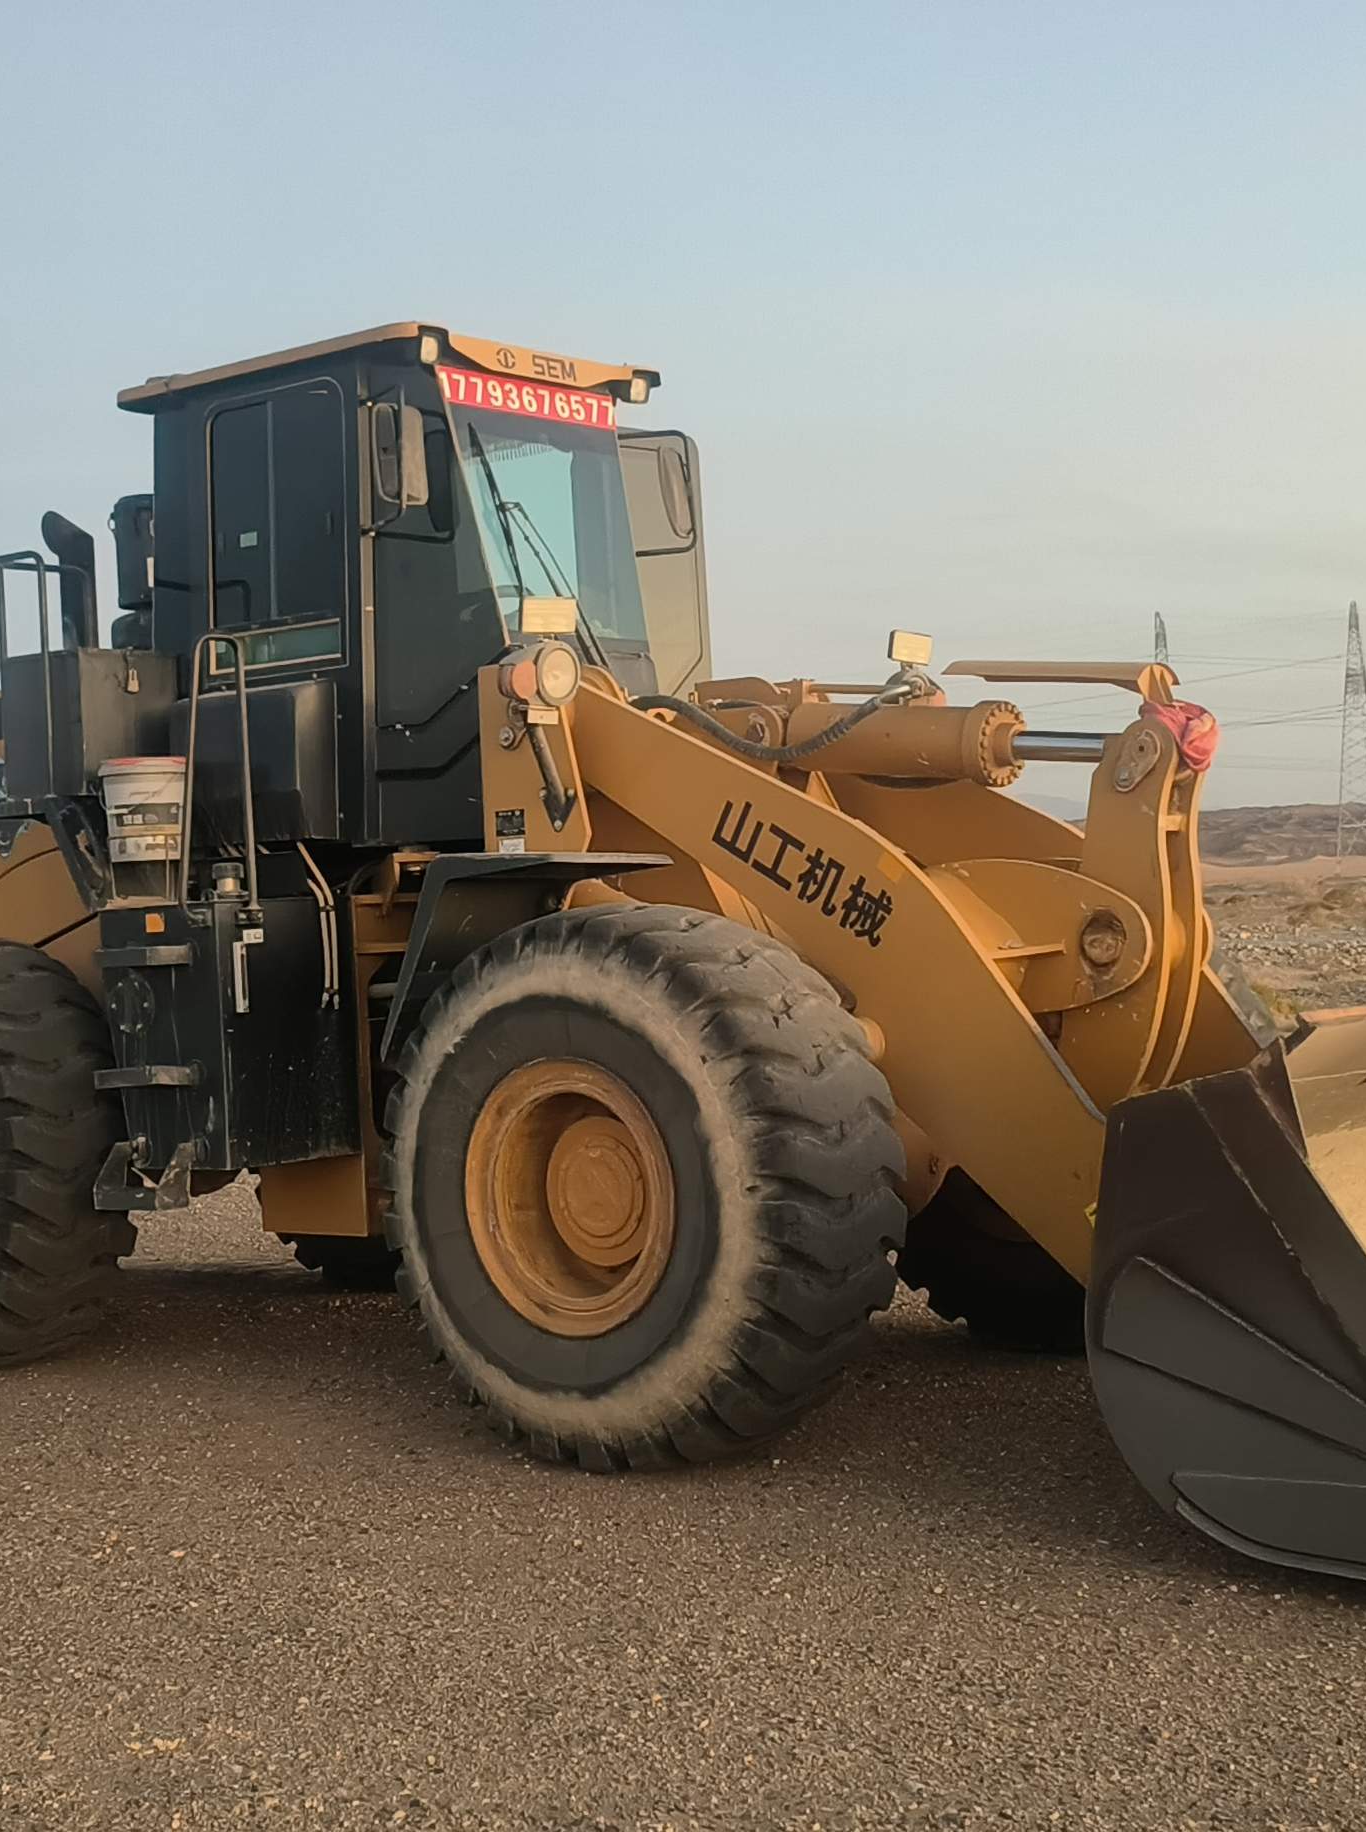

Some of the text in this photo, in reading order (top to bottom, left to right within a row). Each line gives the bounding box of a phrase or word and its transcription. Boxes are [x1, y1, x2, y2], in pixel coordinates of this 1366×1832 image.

[532, 354, 577, 382] SEM
[438, 370, 616, 427] 17793676577
[711, 799, 894, 948] 山工机械
